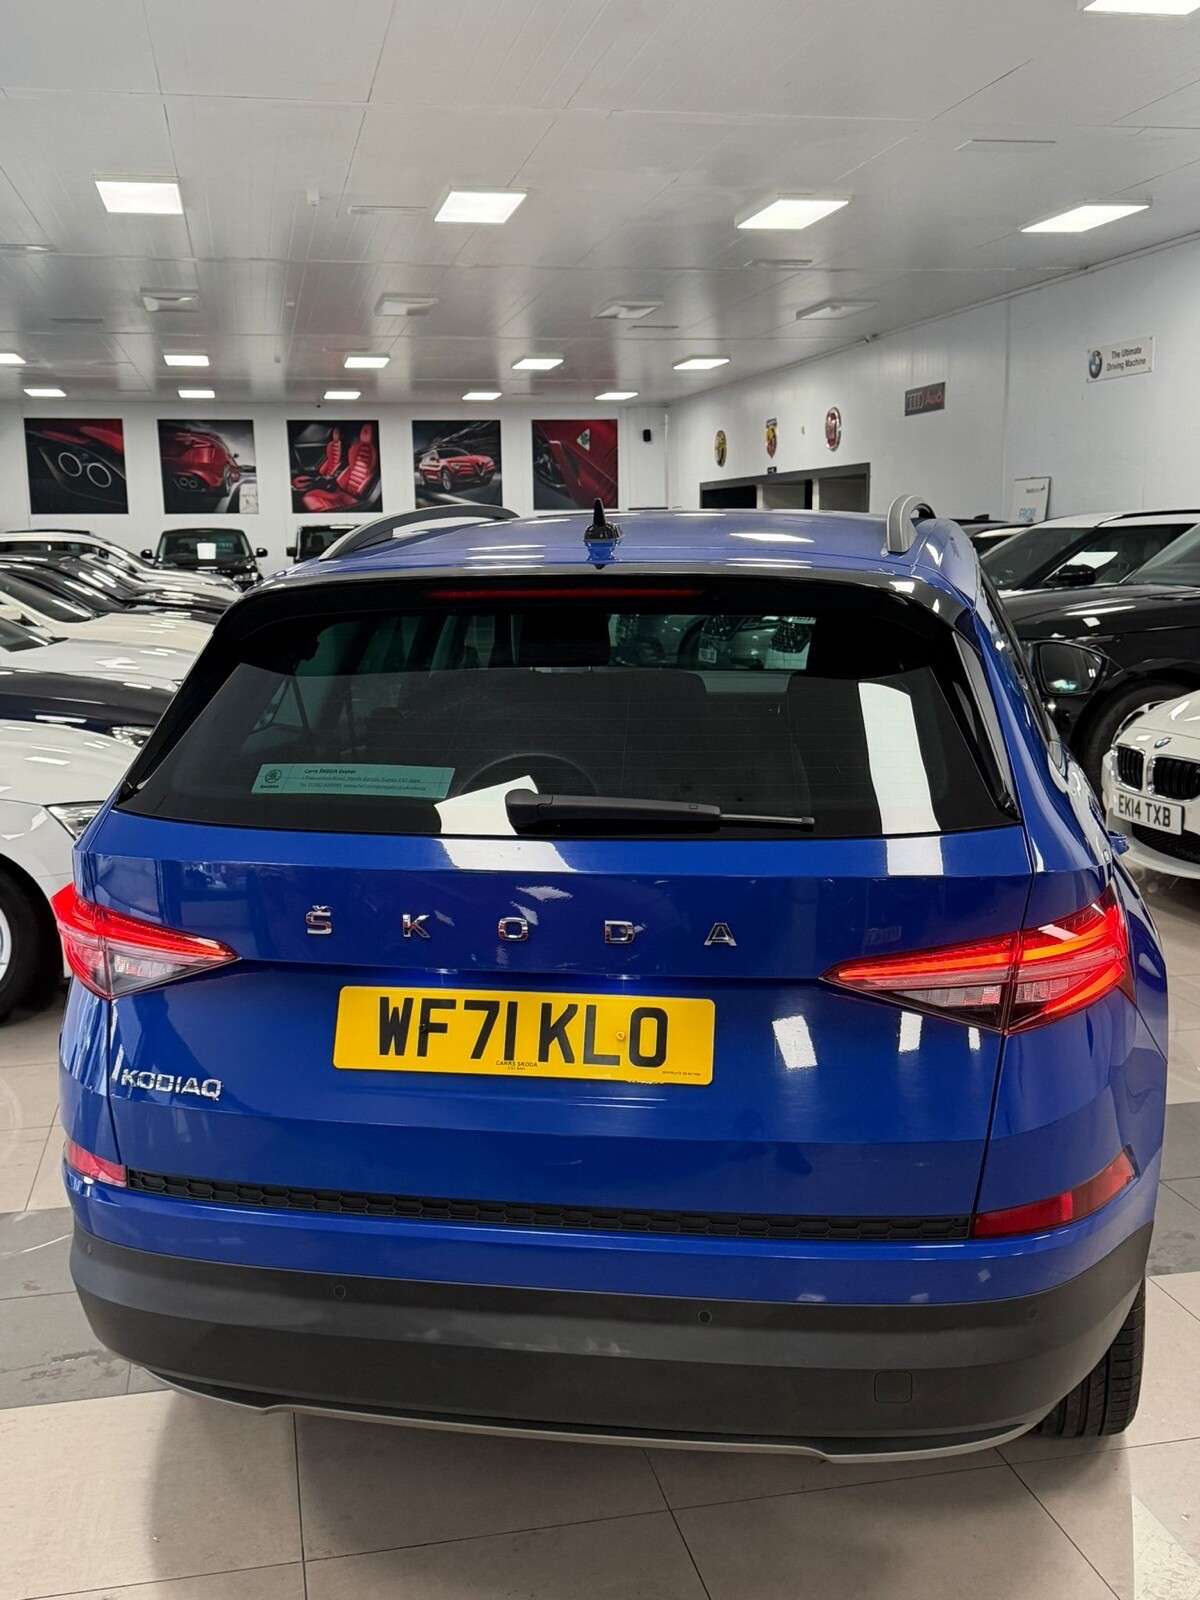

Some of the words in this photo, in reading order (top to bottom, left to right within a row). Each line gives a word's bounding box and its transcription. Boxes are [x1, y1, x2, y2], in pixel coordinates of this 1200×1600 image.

[1106, 362, 1124, 371] Driving
[1125, 358, 1146, 368] Machine
[1111, 350, 1120, 360] The
[1121, 347, 1142, 357] Ultimate
[1118, 795, 1142, 820] EK14
[1145, 803, 1171, 828] TXB
[379, 996, 519, 1061] WF71
[538, 1002, 669, 1068] KLO
[120, 1068, 223, 1101] KODIAQ
